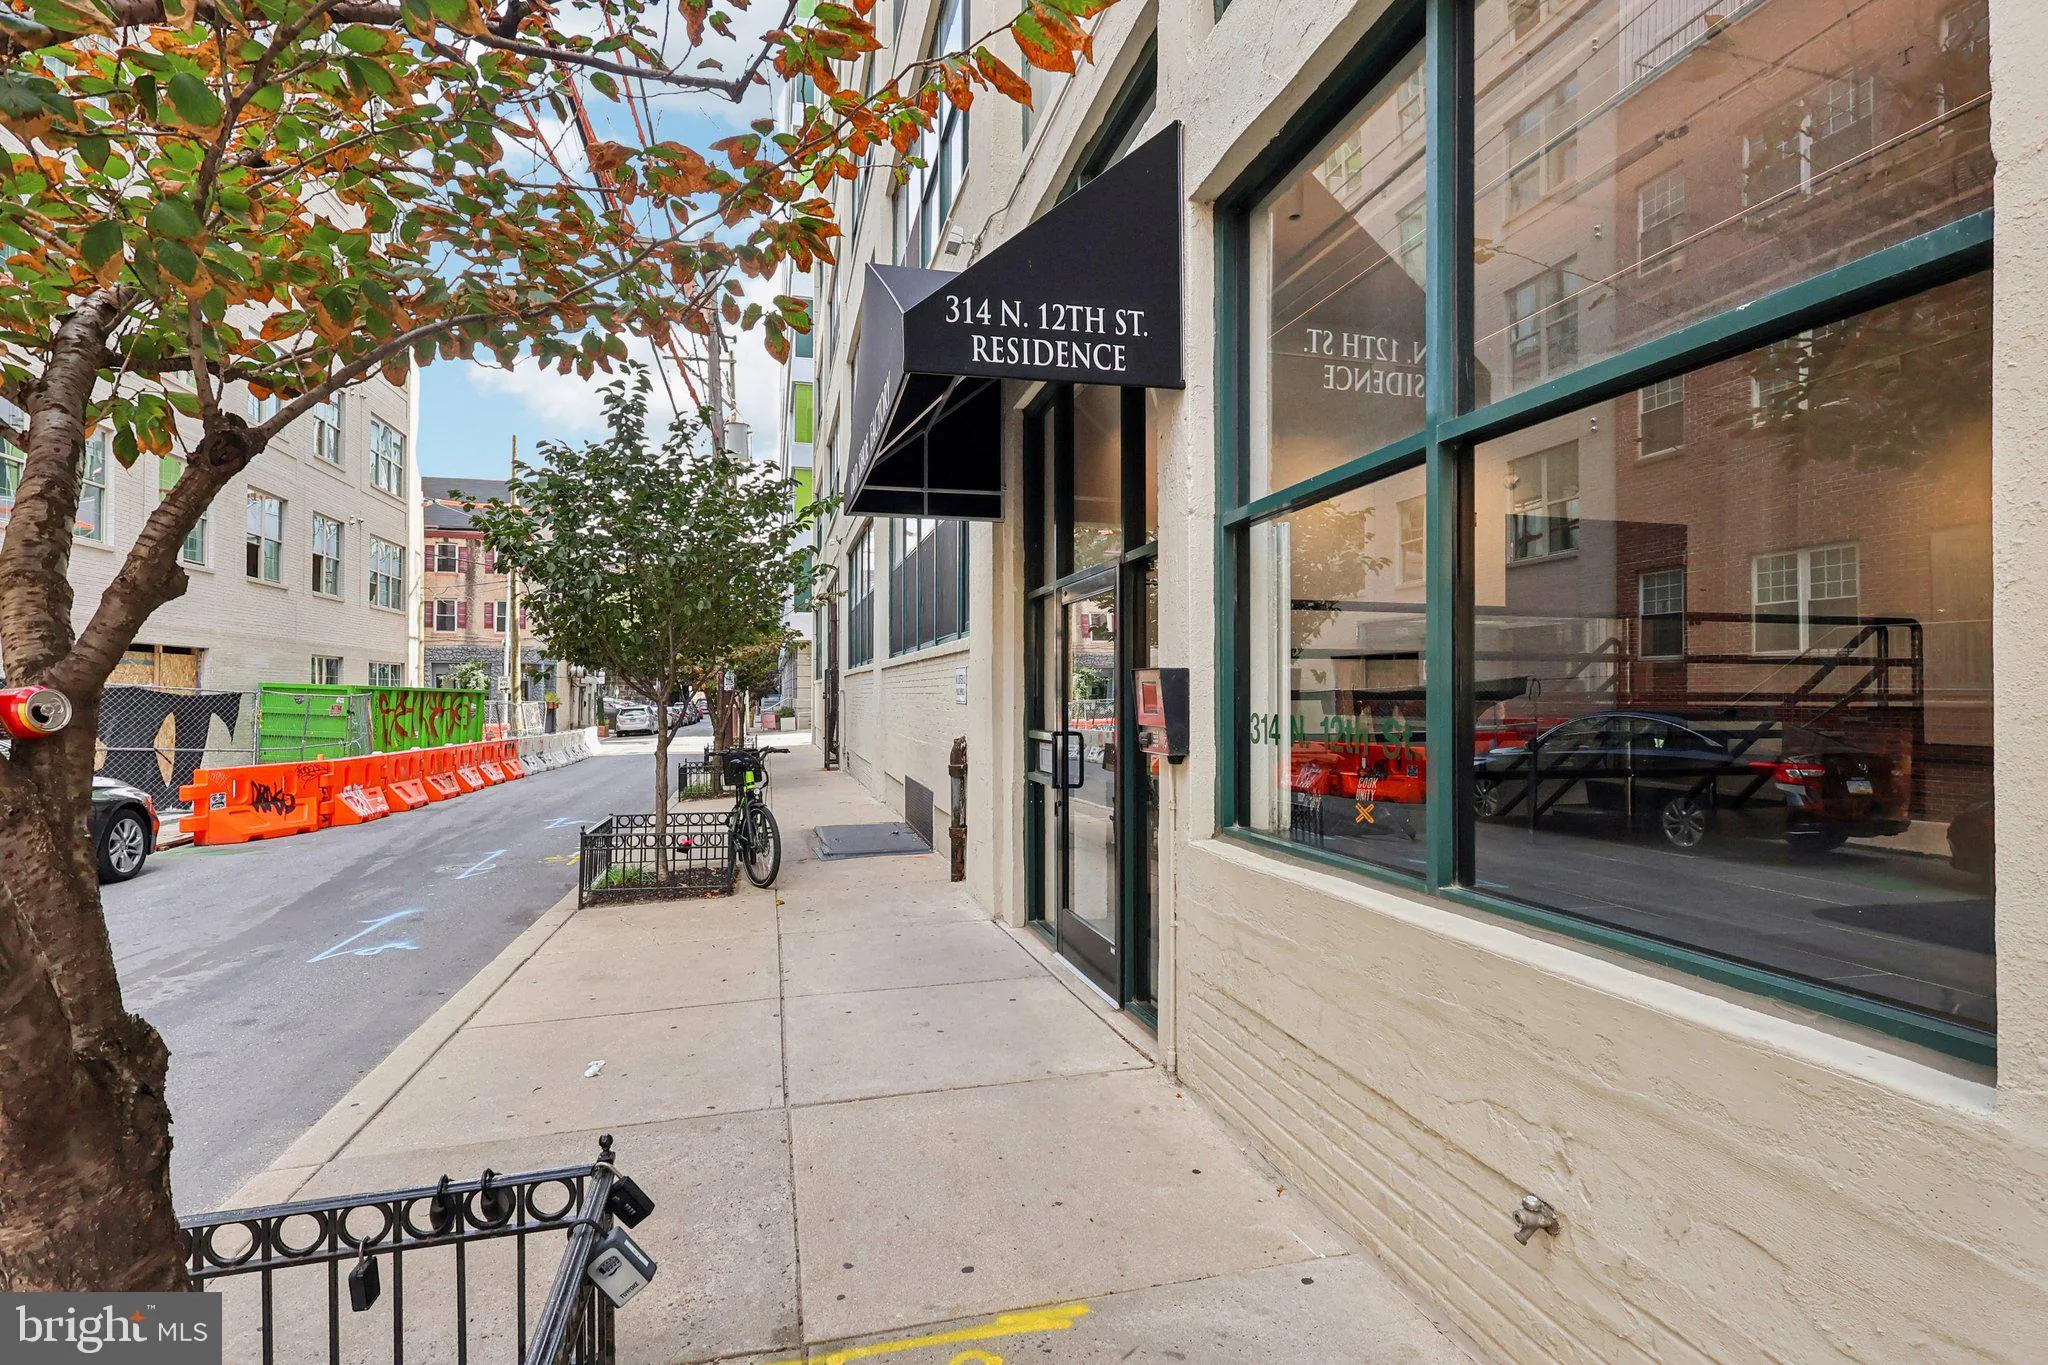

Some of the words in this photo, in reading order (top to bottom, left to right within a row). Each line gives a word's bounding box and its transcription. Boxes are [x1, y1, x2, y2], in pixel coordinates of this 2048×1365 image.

[945, 295, 992, 325] 314
[1000, 299, 1029, 328] N.
[1038, 302, 1106, 334] 12TH
[1115, 308, 1149, 337] ST.
[971, 334, 1127, 372] RESIDENCE
[1250, 712, 1281, 746] 314
[1290, 714, 1310, 749] N.
[1320, 715, 1370, 756] 12th
[1355, 788, 1377, 801] UNITY
[1358, 777, 1379, 789] COOK
